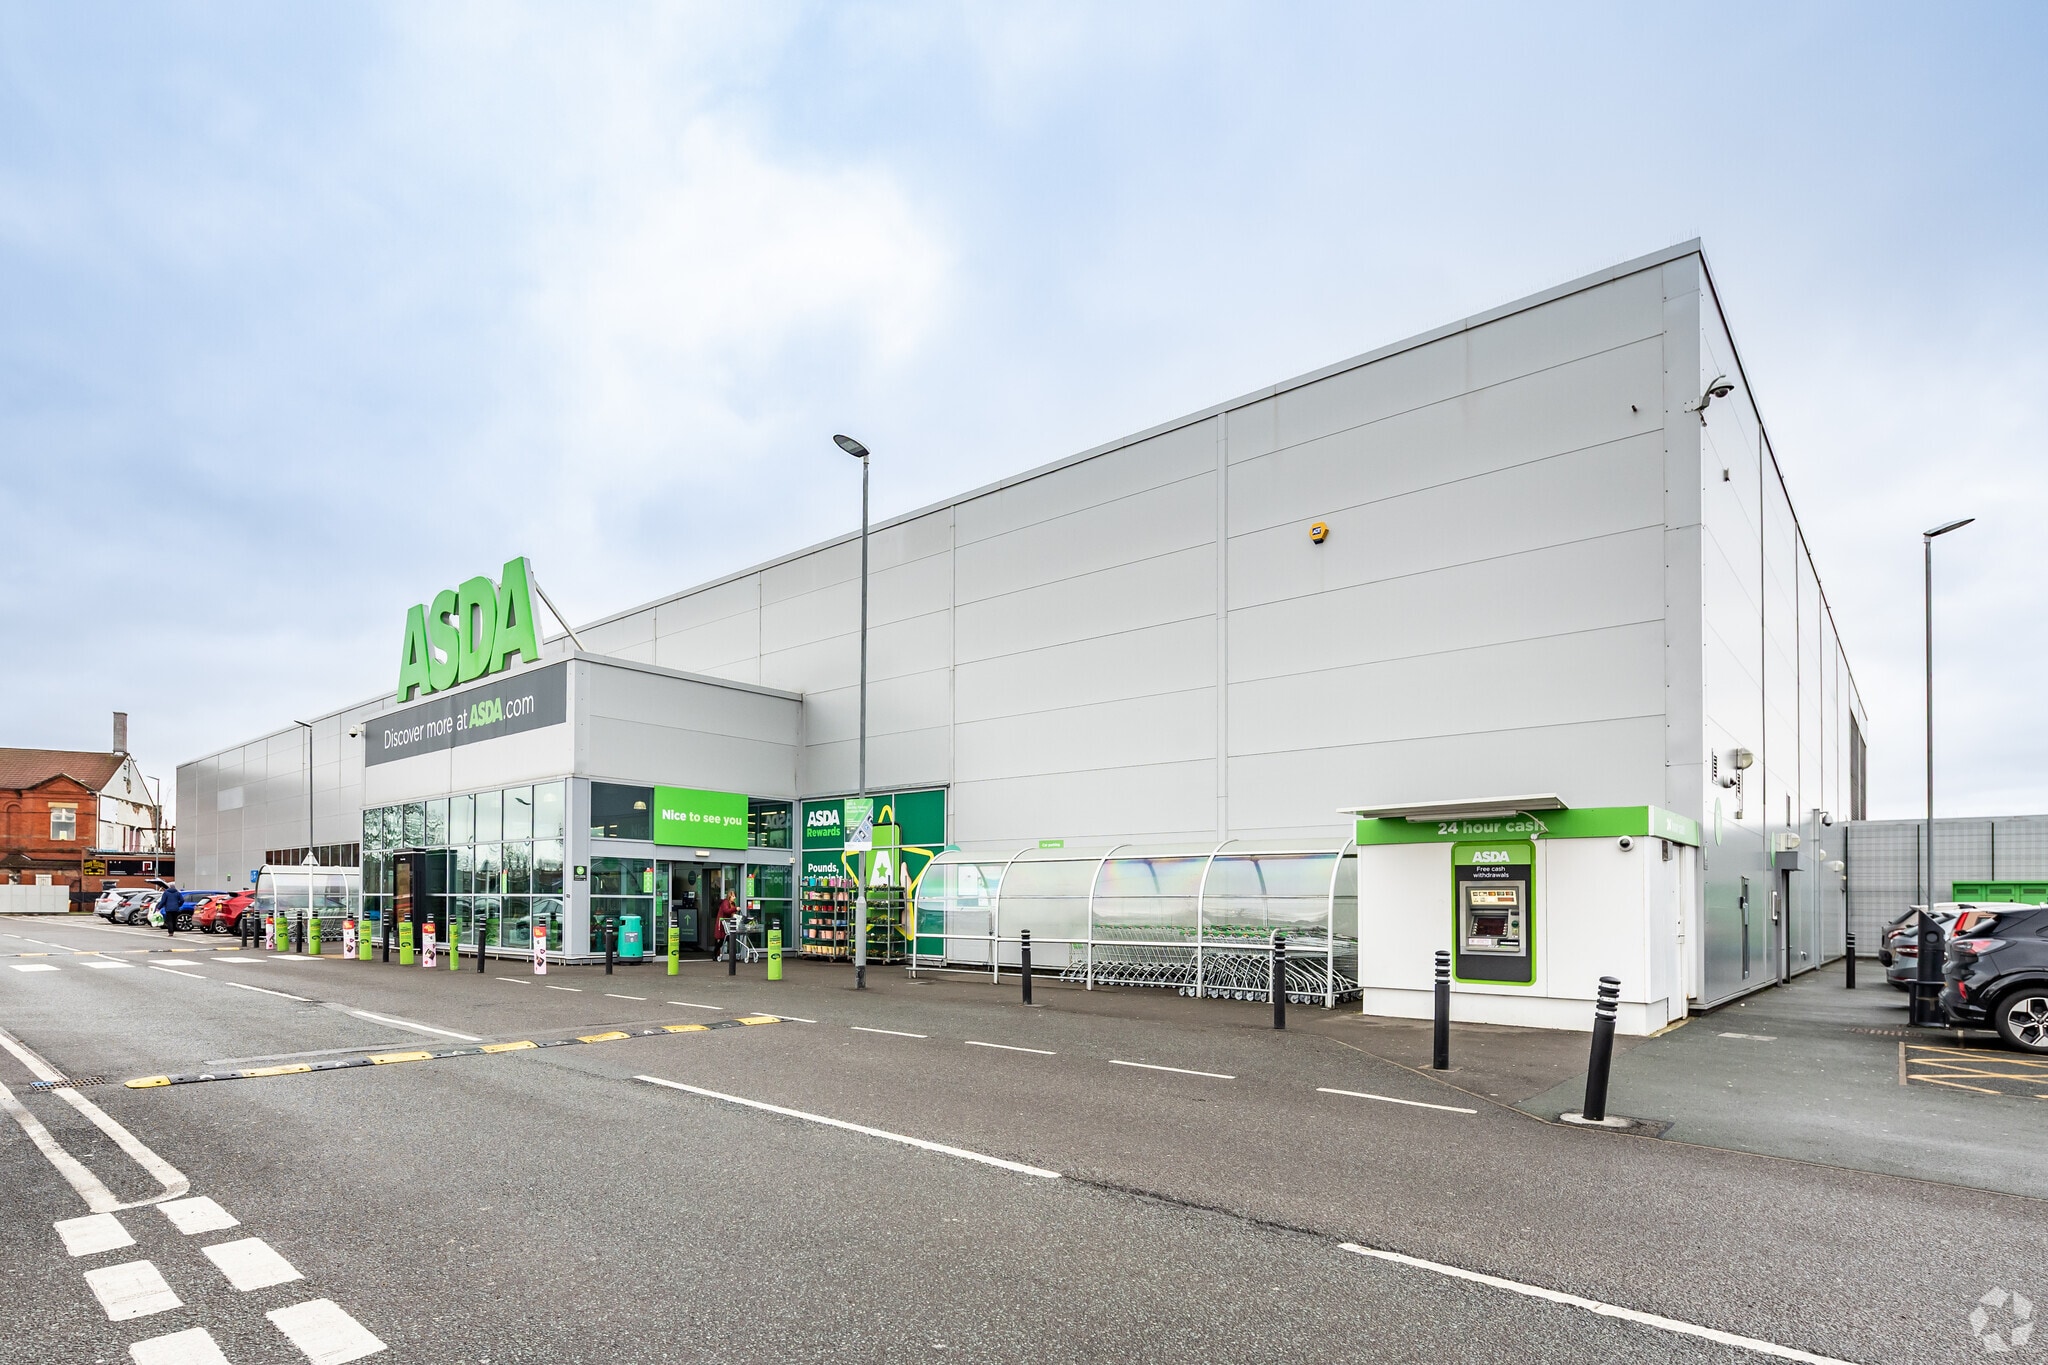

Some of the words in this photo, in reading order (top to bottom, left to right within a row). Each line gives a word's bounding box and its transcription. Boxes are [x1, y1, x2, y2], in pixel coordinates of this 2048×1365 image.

[397, 556, 541, 703] ASDA
[384, 724, 424, 749] Discover
[427, 716, 453, 739] more
[456, 709, 468, 731] at
[469, 695, 534, 729] ASDA.com
[662, 809, 687, 821] Nice
[689, 811, 701, 822] to
[703, 814, 721, 824] see
[723, 816, 742, 826] you
[807, 809, 840, 827] ASDA
[806, 826, 841, 838] Rewards
[1438, 822, 1459, 835] 24
[1463, 821, 1501, 834] hour
[1505, 819, 1545, 832] cash
[1472, 851, 1510, 863] ASDA
[807, 862, 840, 873] Pounds,
